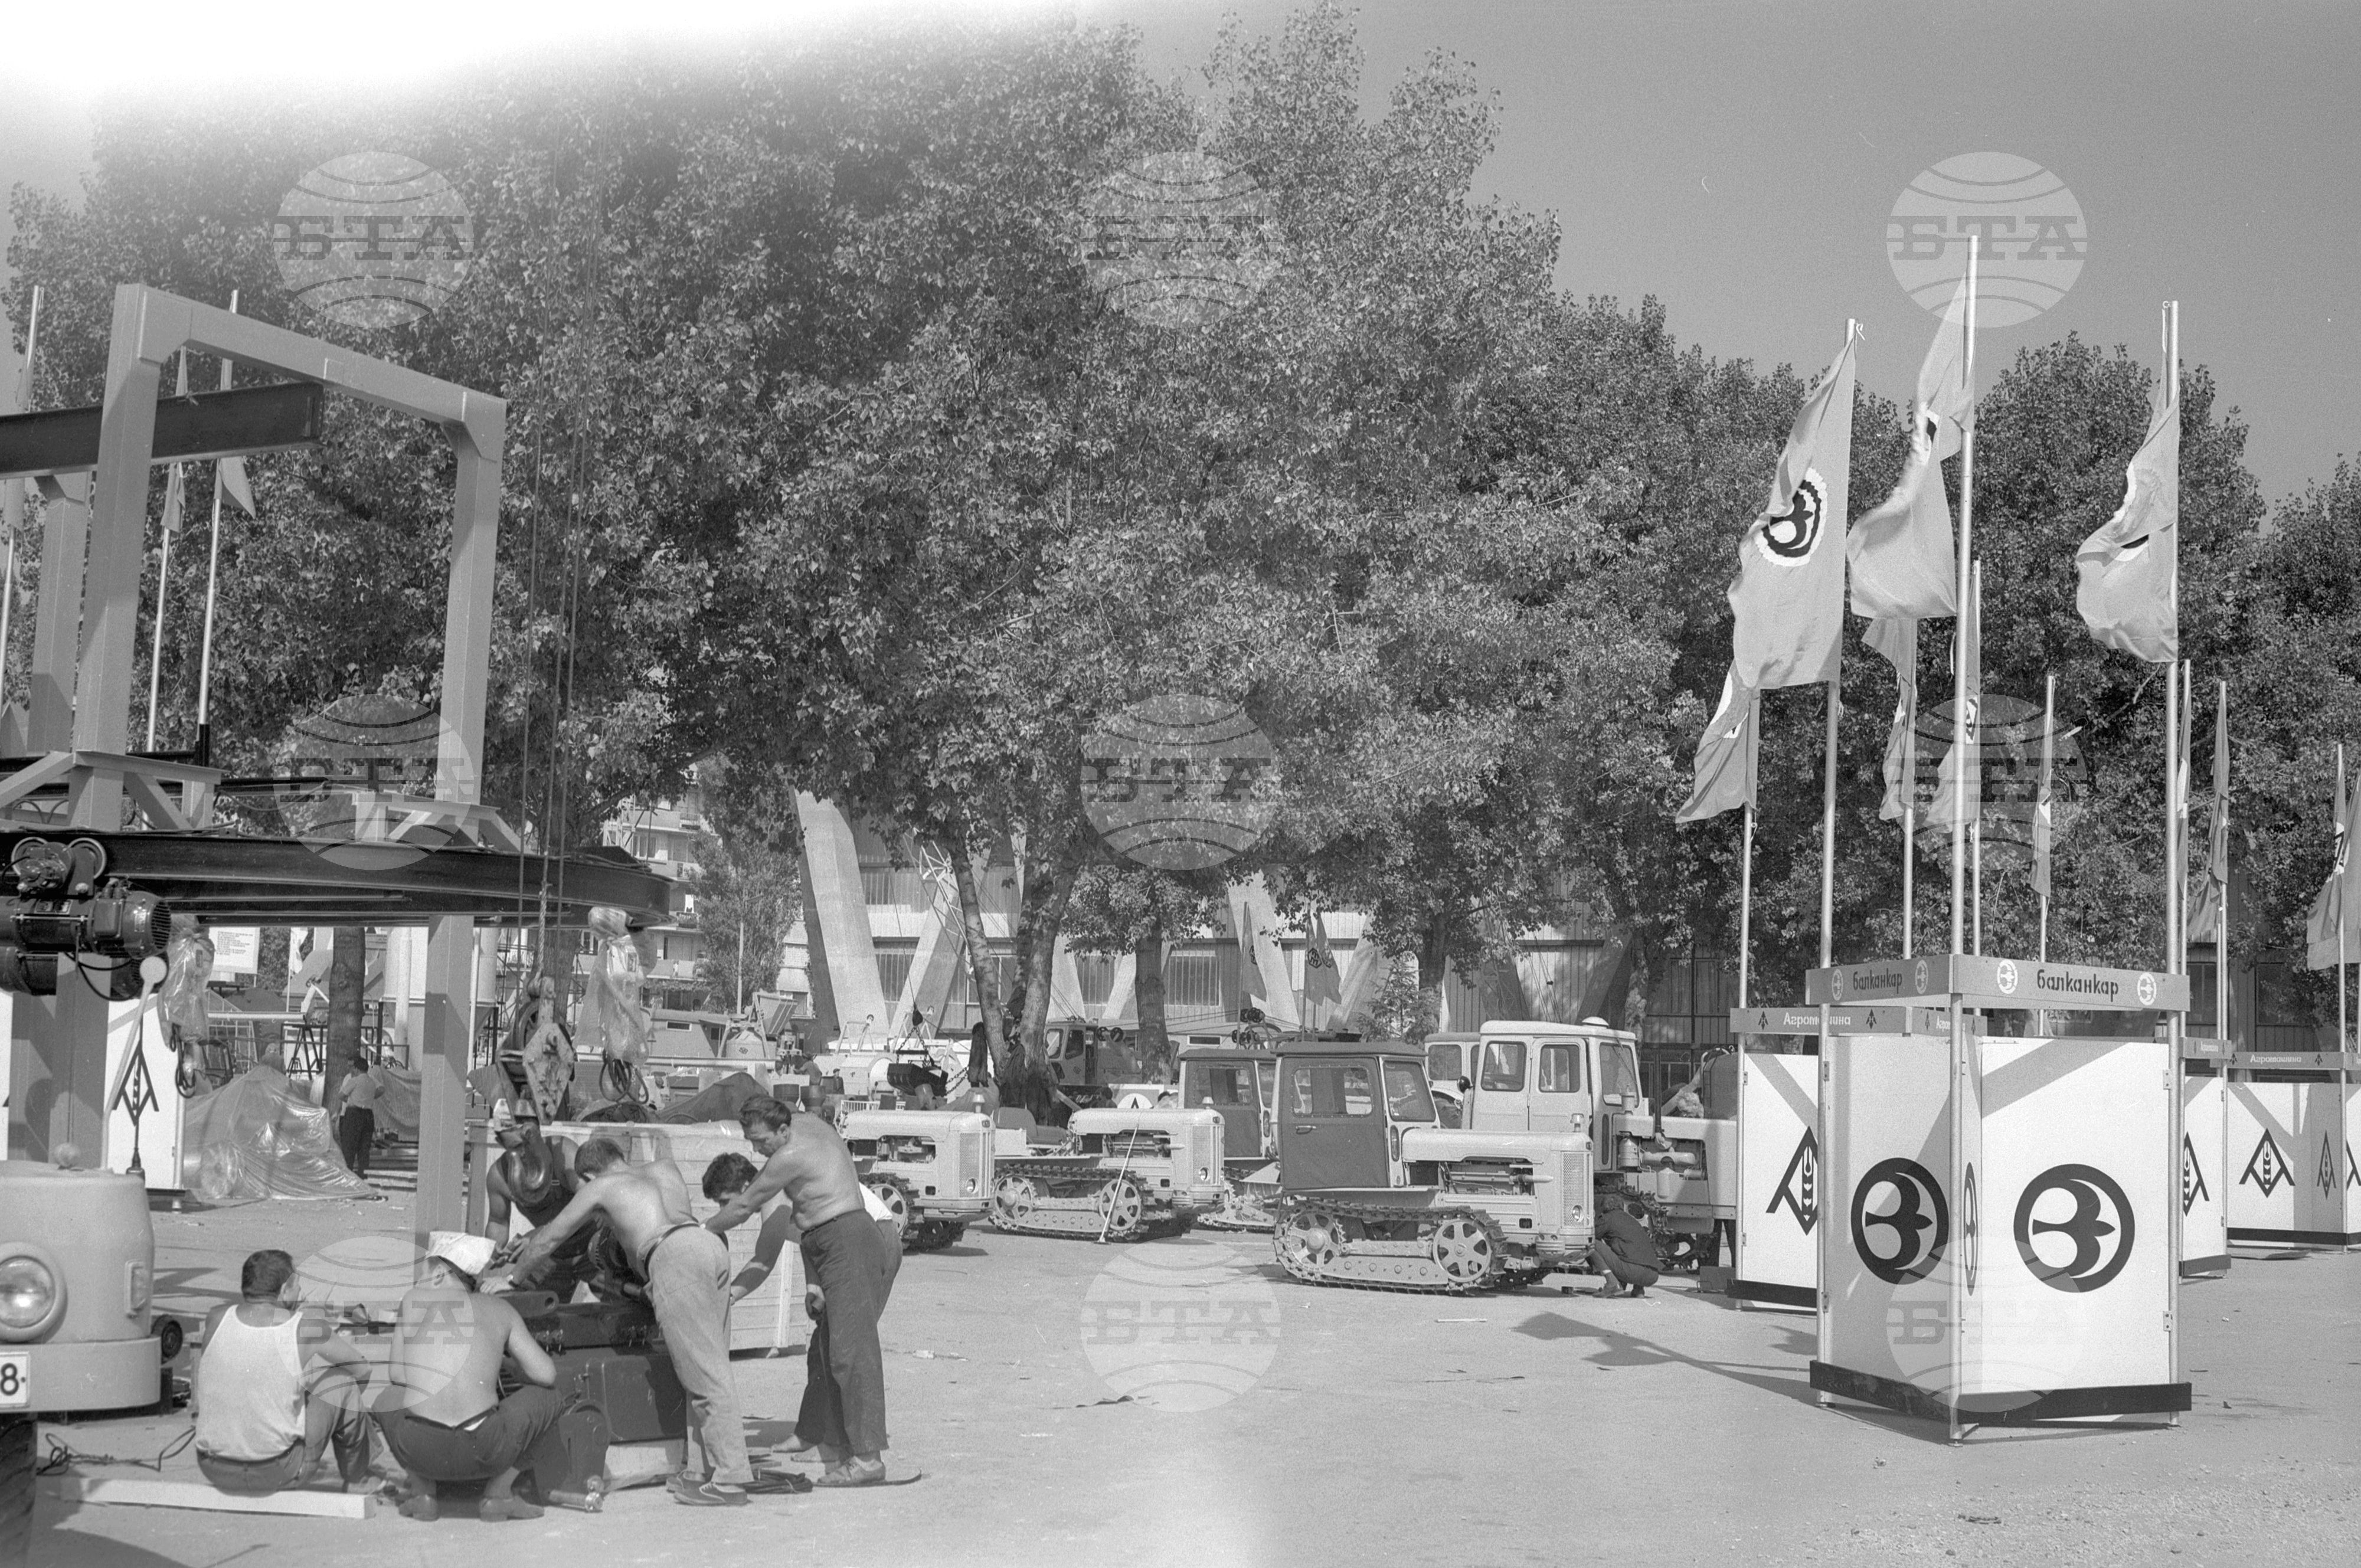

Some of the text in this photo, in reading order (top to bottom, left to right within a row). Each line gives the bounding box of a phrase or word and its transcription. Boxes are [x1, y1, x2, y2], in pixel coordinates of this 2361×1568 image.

[2037, 969, 2119, 1002] балканкар
[1783, 1012, 1851, 1028] Агромина
[1, 1363, 19, 1396] 8
